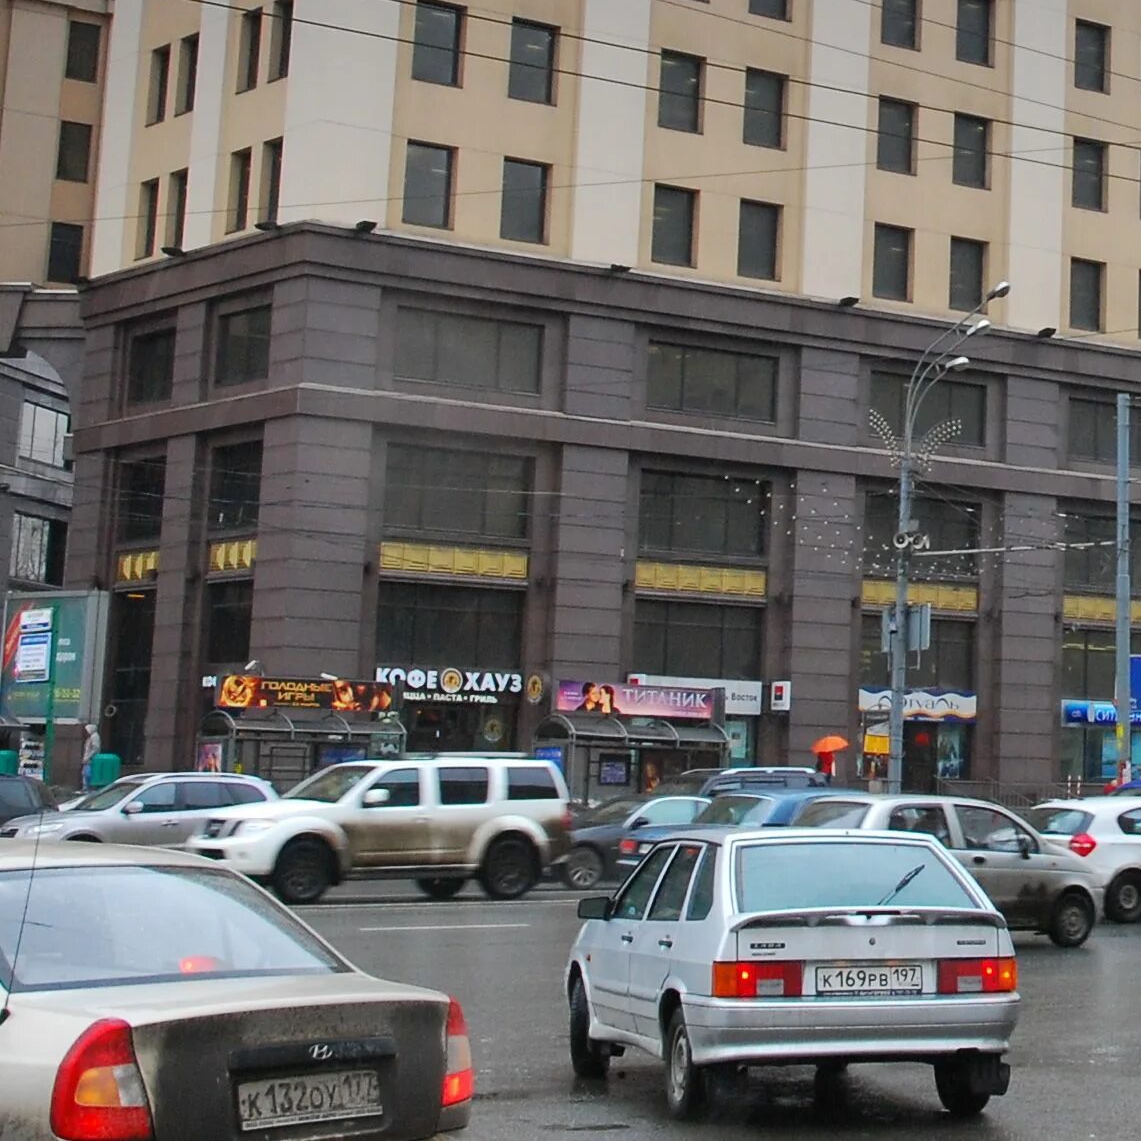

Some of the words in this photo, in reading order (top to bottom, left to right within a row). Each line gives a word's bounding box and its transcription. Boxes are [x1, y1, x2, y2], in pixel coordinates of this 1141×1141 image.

[376, 667, 438, 689] КОФЕ
[464, 671, 522, 692] ХАУЗ
[261, 681, 332, 693] ГОЛОДНЫЕ
[277, 691, 315, 702] ИГРЫ
[433, 692, 463, 702] ПАСТА
[622, 688, 708, 709] ТИТАНИК
[731, 692, 758, 702] Восток
